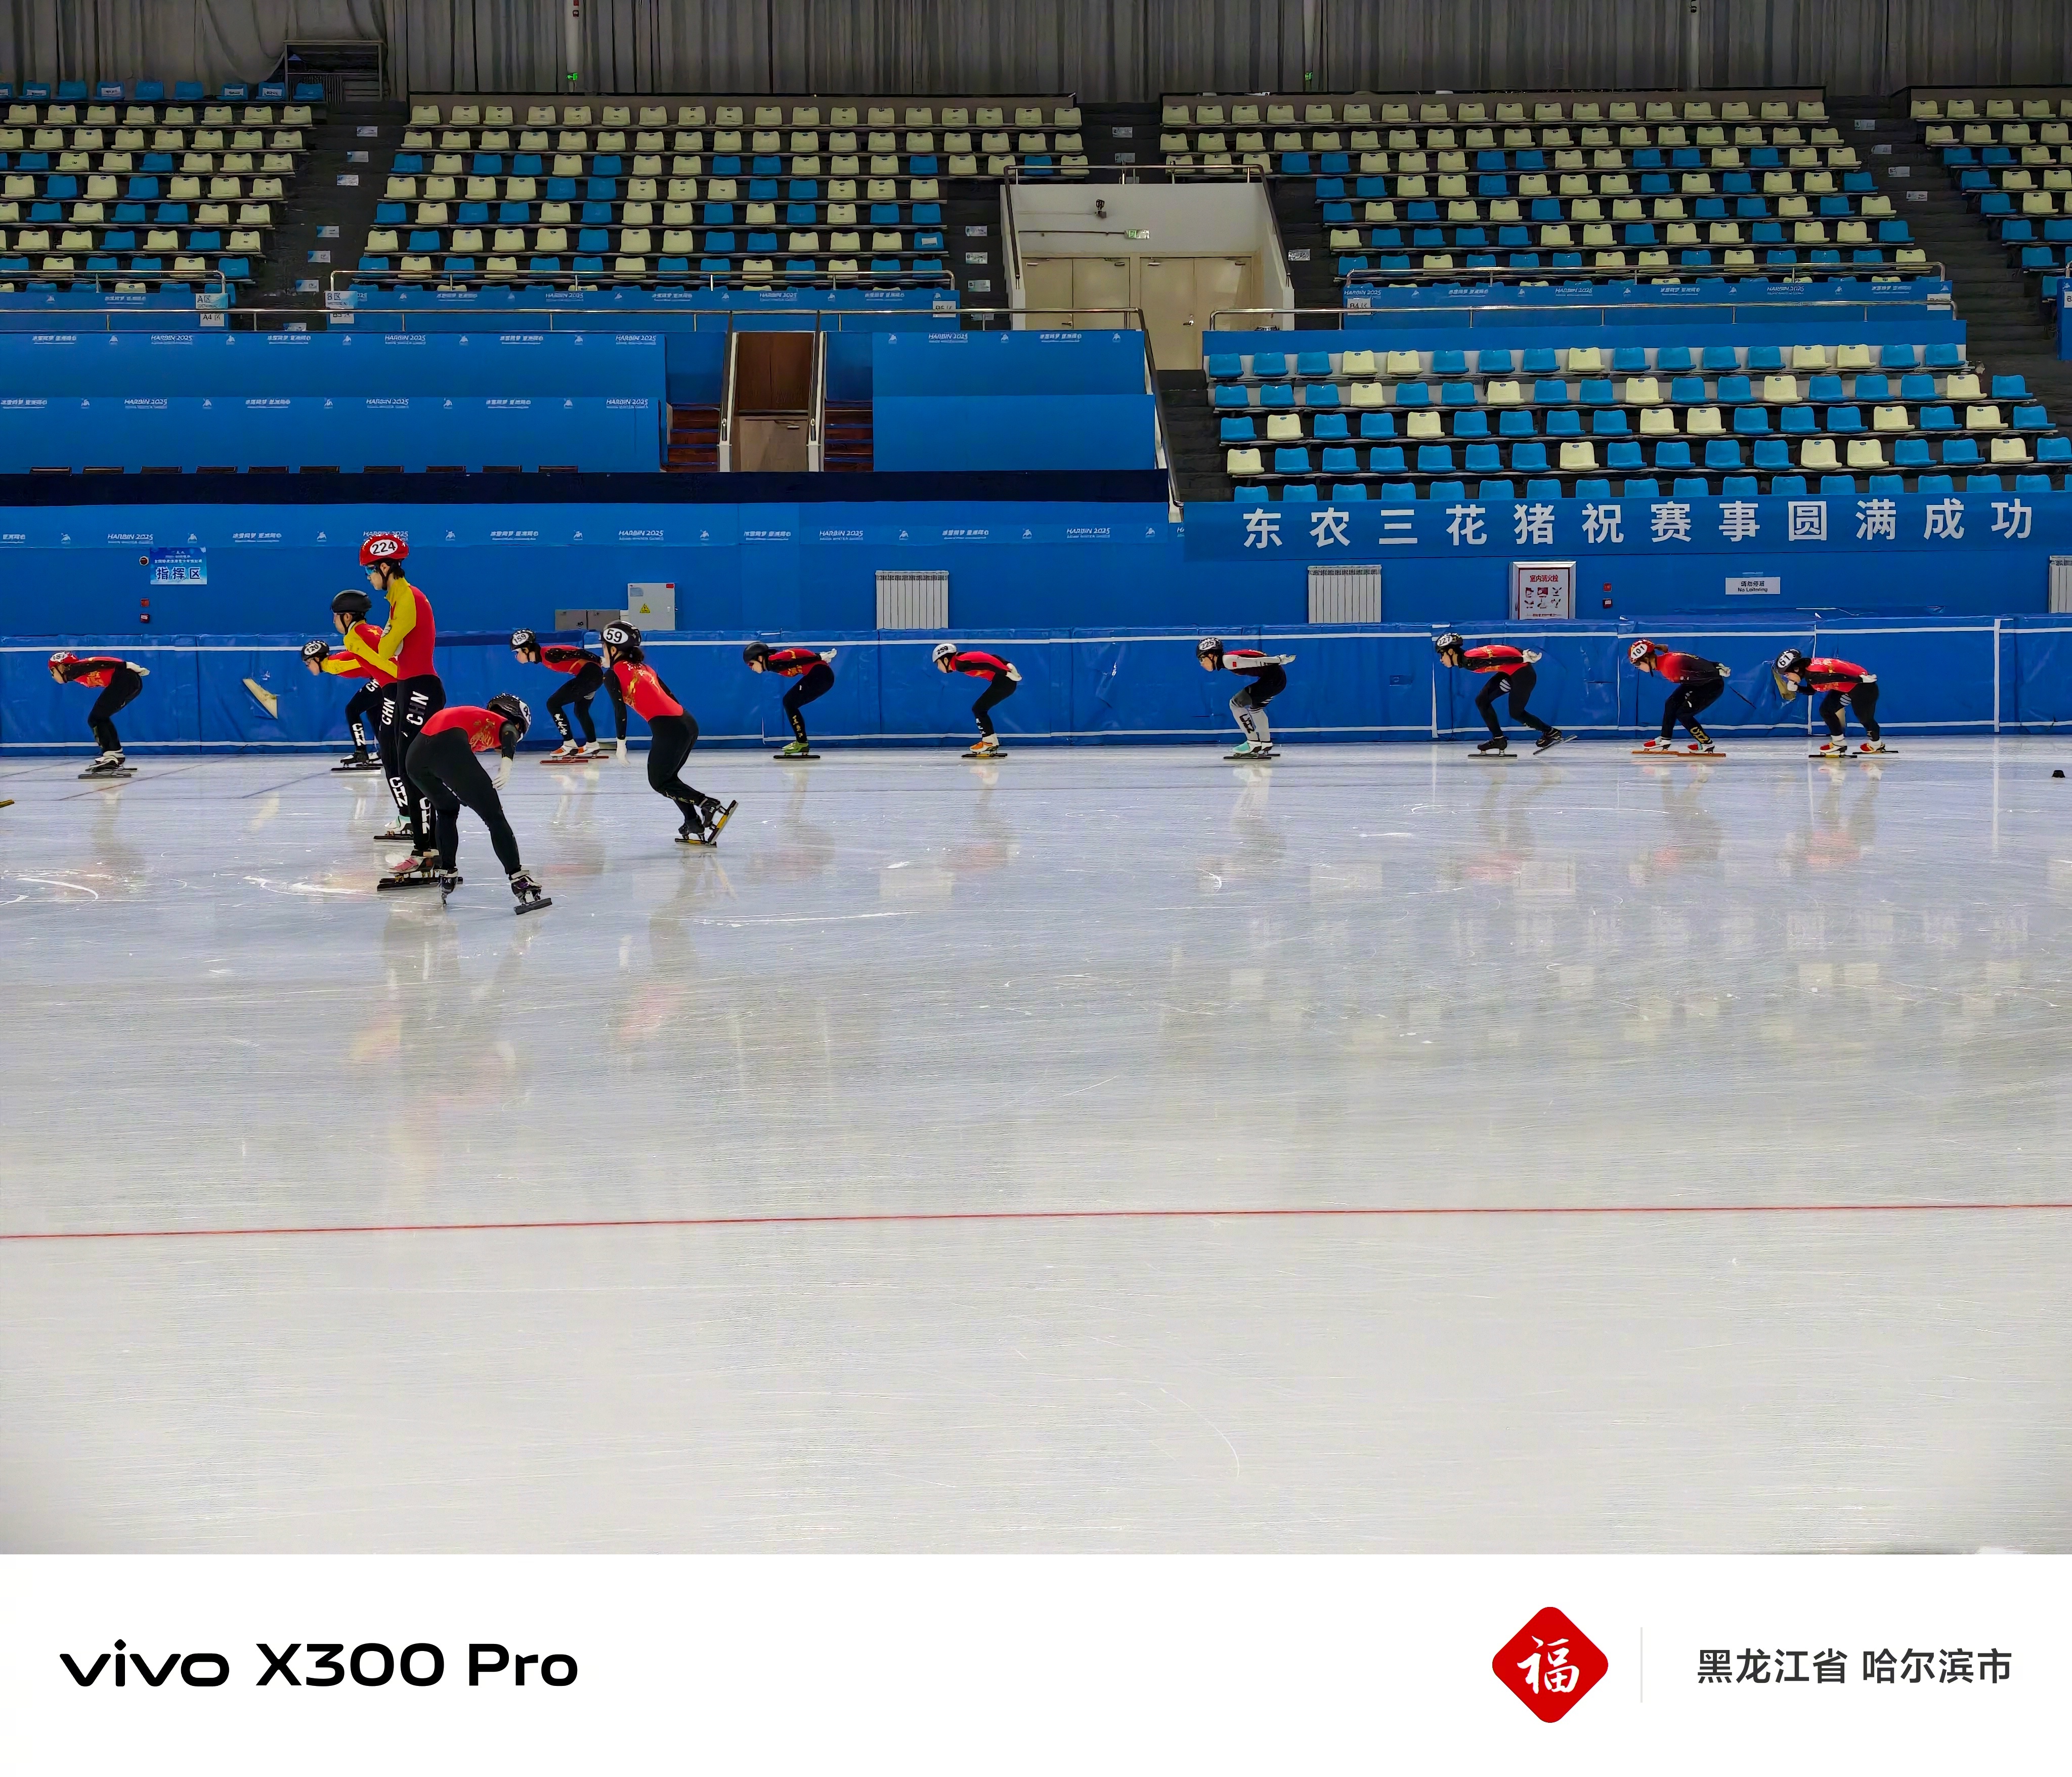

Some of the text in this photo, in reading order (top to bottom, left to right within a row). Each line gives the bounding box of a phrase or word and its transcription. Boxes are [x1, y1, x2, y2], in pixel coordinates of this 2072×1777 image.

[1243, 498, 2032, 548] 东农三花猪祝赛事圆满成功
[372, 541, 396, 554] 224
[156, 567, 201, 580] 指挥区
[513, 633, 527, 644] 159
[606, 629, 623, 643] 59
[306, 644, 319, 653] 120
[1633, 645, 1645, 657] 101
[1779, 654, 1791, 666] 61
[365, 678, 381, 692] CH
[382, 697, 396, 725] CHN
[406, 691, 429, 726] CHN
[352, 723, 366, 746] CHN
[389, 777, 408, 807] CHN
[419, 797, 431, 834] CHN
